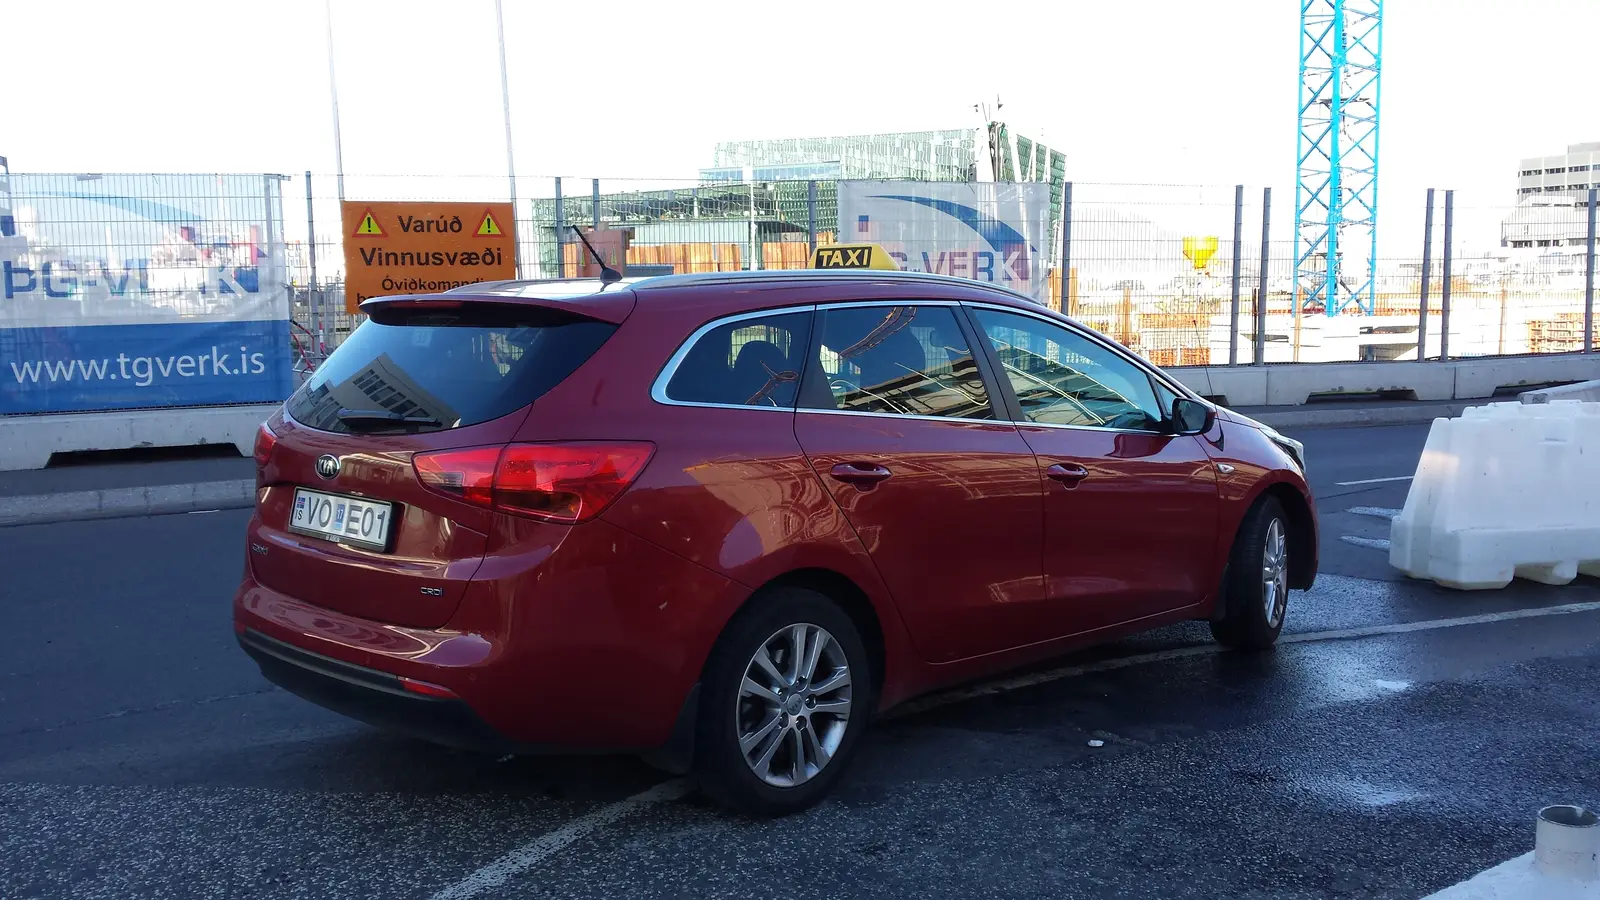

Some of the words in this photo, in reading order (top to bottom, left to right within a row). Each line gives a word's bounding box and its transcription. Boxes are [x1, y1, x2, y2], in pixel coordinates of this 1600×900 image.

[397, 215, 463, 233] Varúð
[359, 247, 502, 266] Vinnusvæði
[819, 249, 869, 267] TAXI
[10, 345, 265, 387] www.tgverk.is
